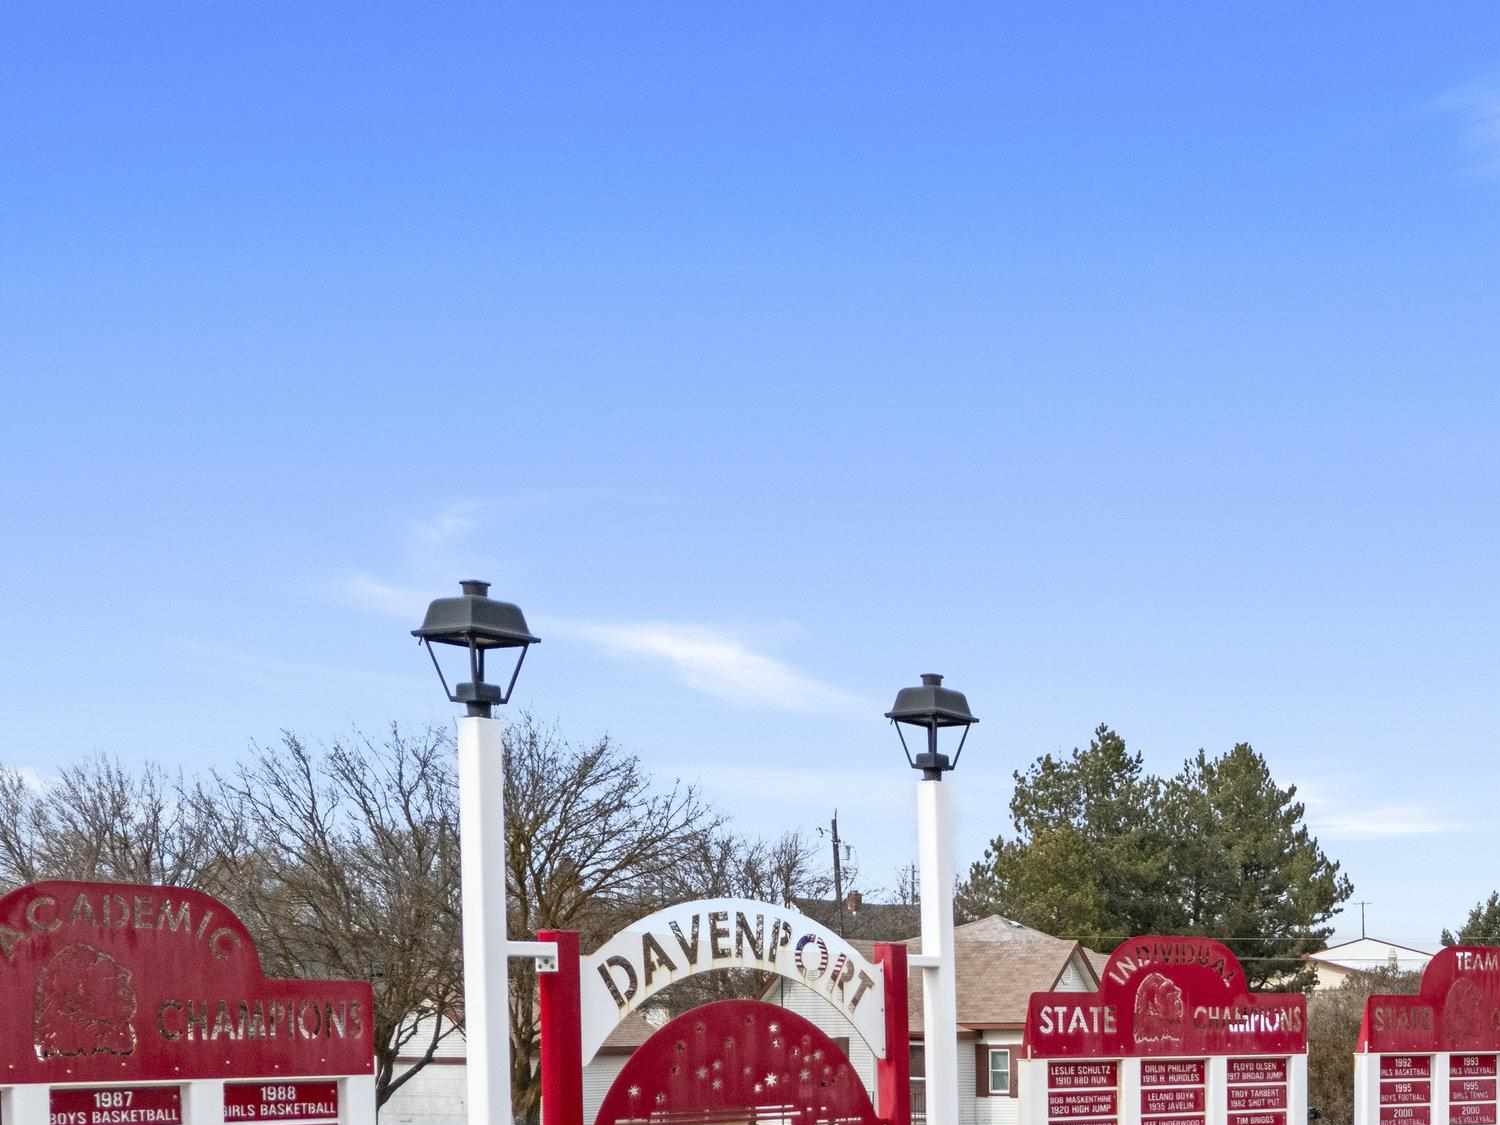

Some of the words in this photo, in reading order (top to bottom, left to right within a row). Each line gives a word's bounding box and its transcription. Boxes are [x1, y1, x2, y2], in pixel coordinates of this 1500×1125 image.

[0, 893, 241, 961] ACADEMIC
[597, 911, 876, 1009] DAVENPORT
[1456, 951, 1499, 972] TEAM
[158, 999, 364, 1040] CHAMPIONS
[1040, 1006, 1117, 1034] STATE
[1193, 1005, 1300, 1034] CHAMPIONS
[1051, 1066, 1074, 1075] LESLIE
[1078, 1065, 1109, 1074] SCHULTZ
[95, 1091, 132, 1108] 1987
[261, 1086, 295, 1101] 1988
[51, 1111, 86, 1125] BOYS
[92, 1107, 177, 1124] BASKETBALL
[260, 1101, 335, 1115] BASKETBALL
[1051, 1105, 1069, 1114] 1920
[1072, 1105, 1089, 1113] HIGH
[1092, 1104, 1110, 1112] JUMP
[1236, 1116, 1248, 1124] TIM
